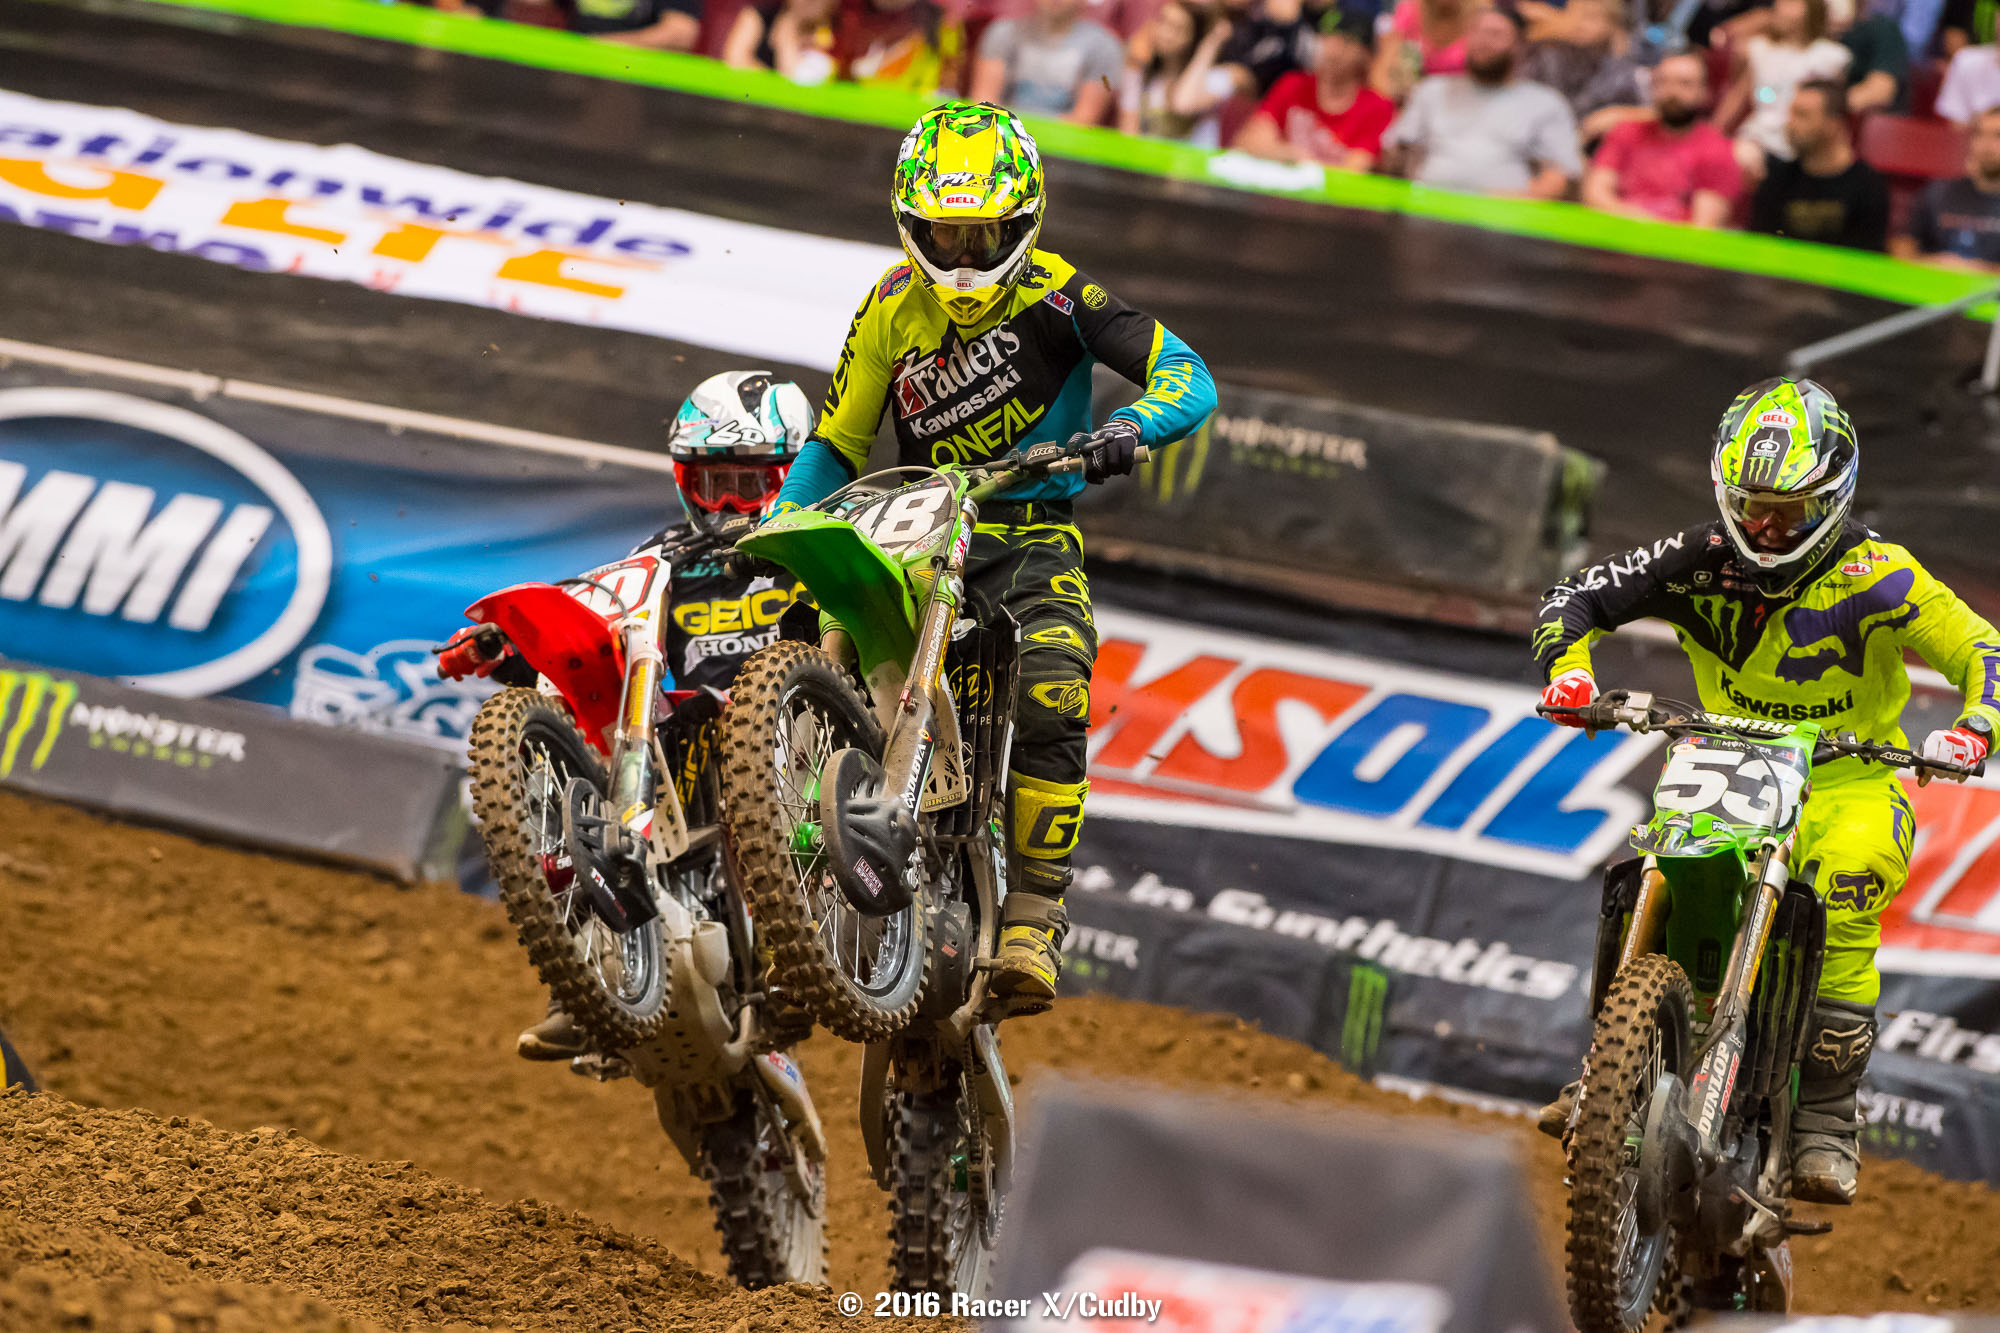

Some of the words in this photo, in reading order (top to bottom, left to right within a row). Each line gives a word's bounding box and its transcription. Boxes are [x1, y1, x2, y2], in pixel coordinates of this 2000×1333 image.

[945, 196, 977, 204] BELL
[909, 364, 1022, 440] Kawasaki
[931, 396, 1045, 466] O'NEAL
[1762, 414, 1791, 425] BELL
[1843, 564, 1867, 573] BELL
[1720, 670, 1855, 721] Kawasaki
[1655, 748, 1806, 830] 53
[1699, 1041, 1730, 1137] DUNLOP
